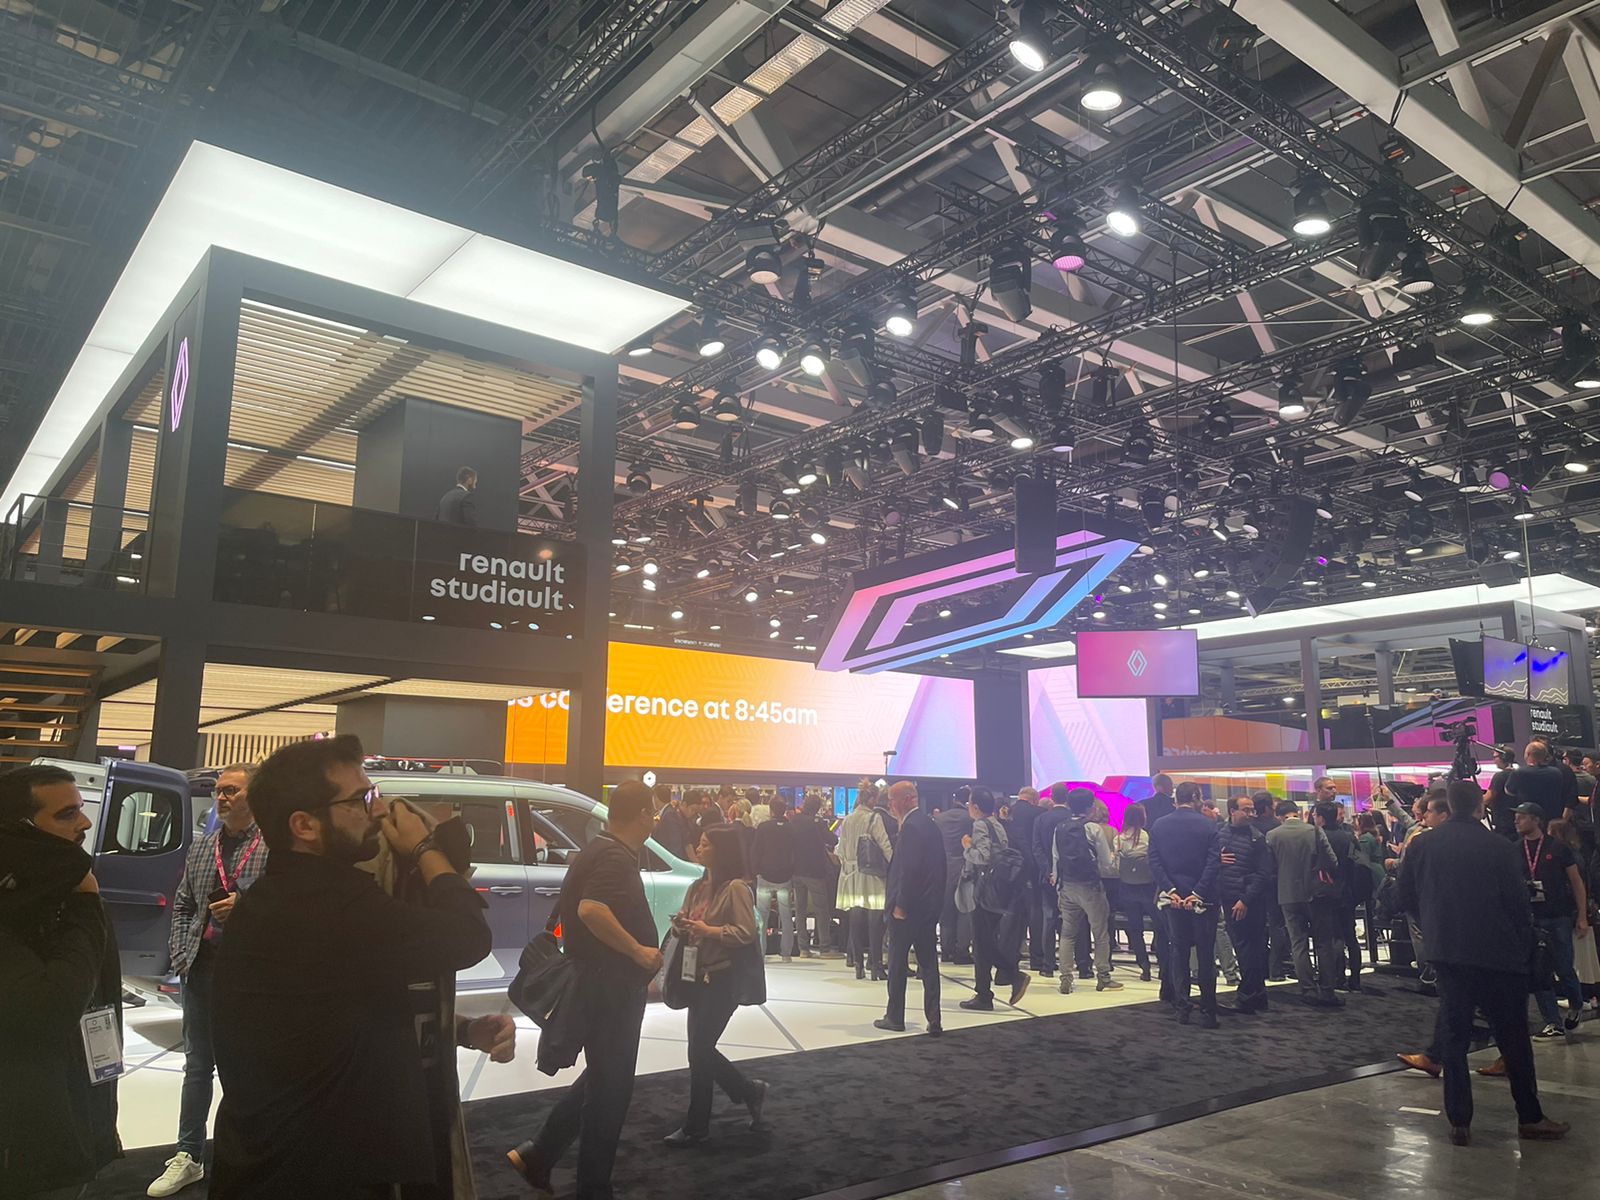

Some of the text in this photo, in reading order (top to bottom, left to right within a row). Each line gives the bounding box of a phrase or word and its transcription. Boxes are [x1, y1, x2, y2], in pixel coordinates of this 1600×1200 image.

[460, 553, 565, 584] renault
[430, 577, 563, 611] studiault
[703, 700, 730, 720] at
[734, 699, 818, 725] 8:45am
